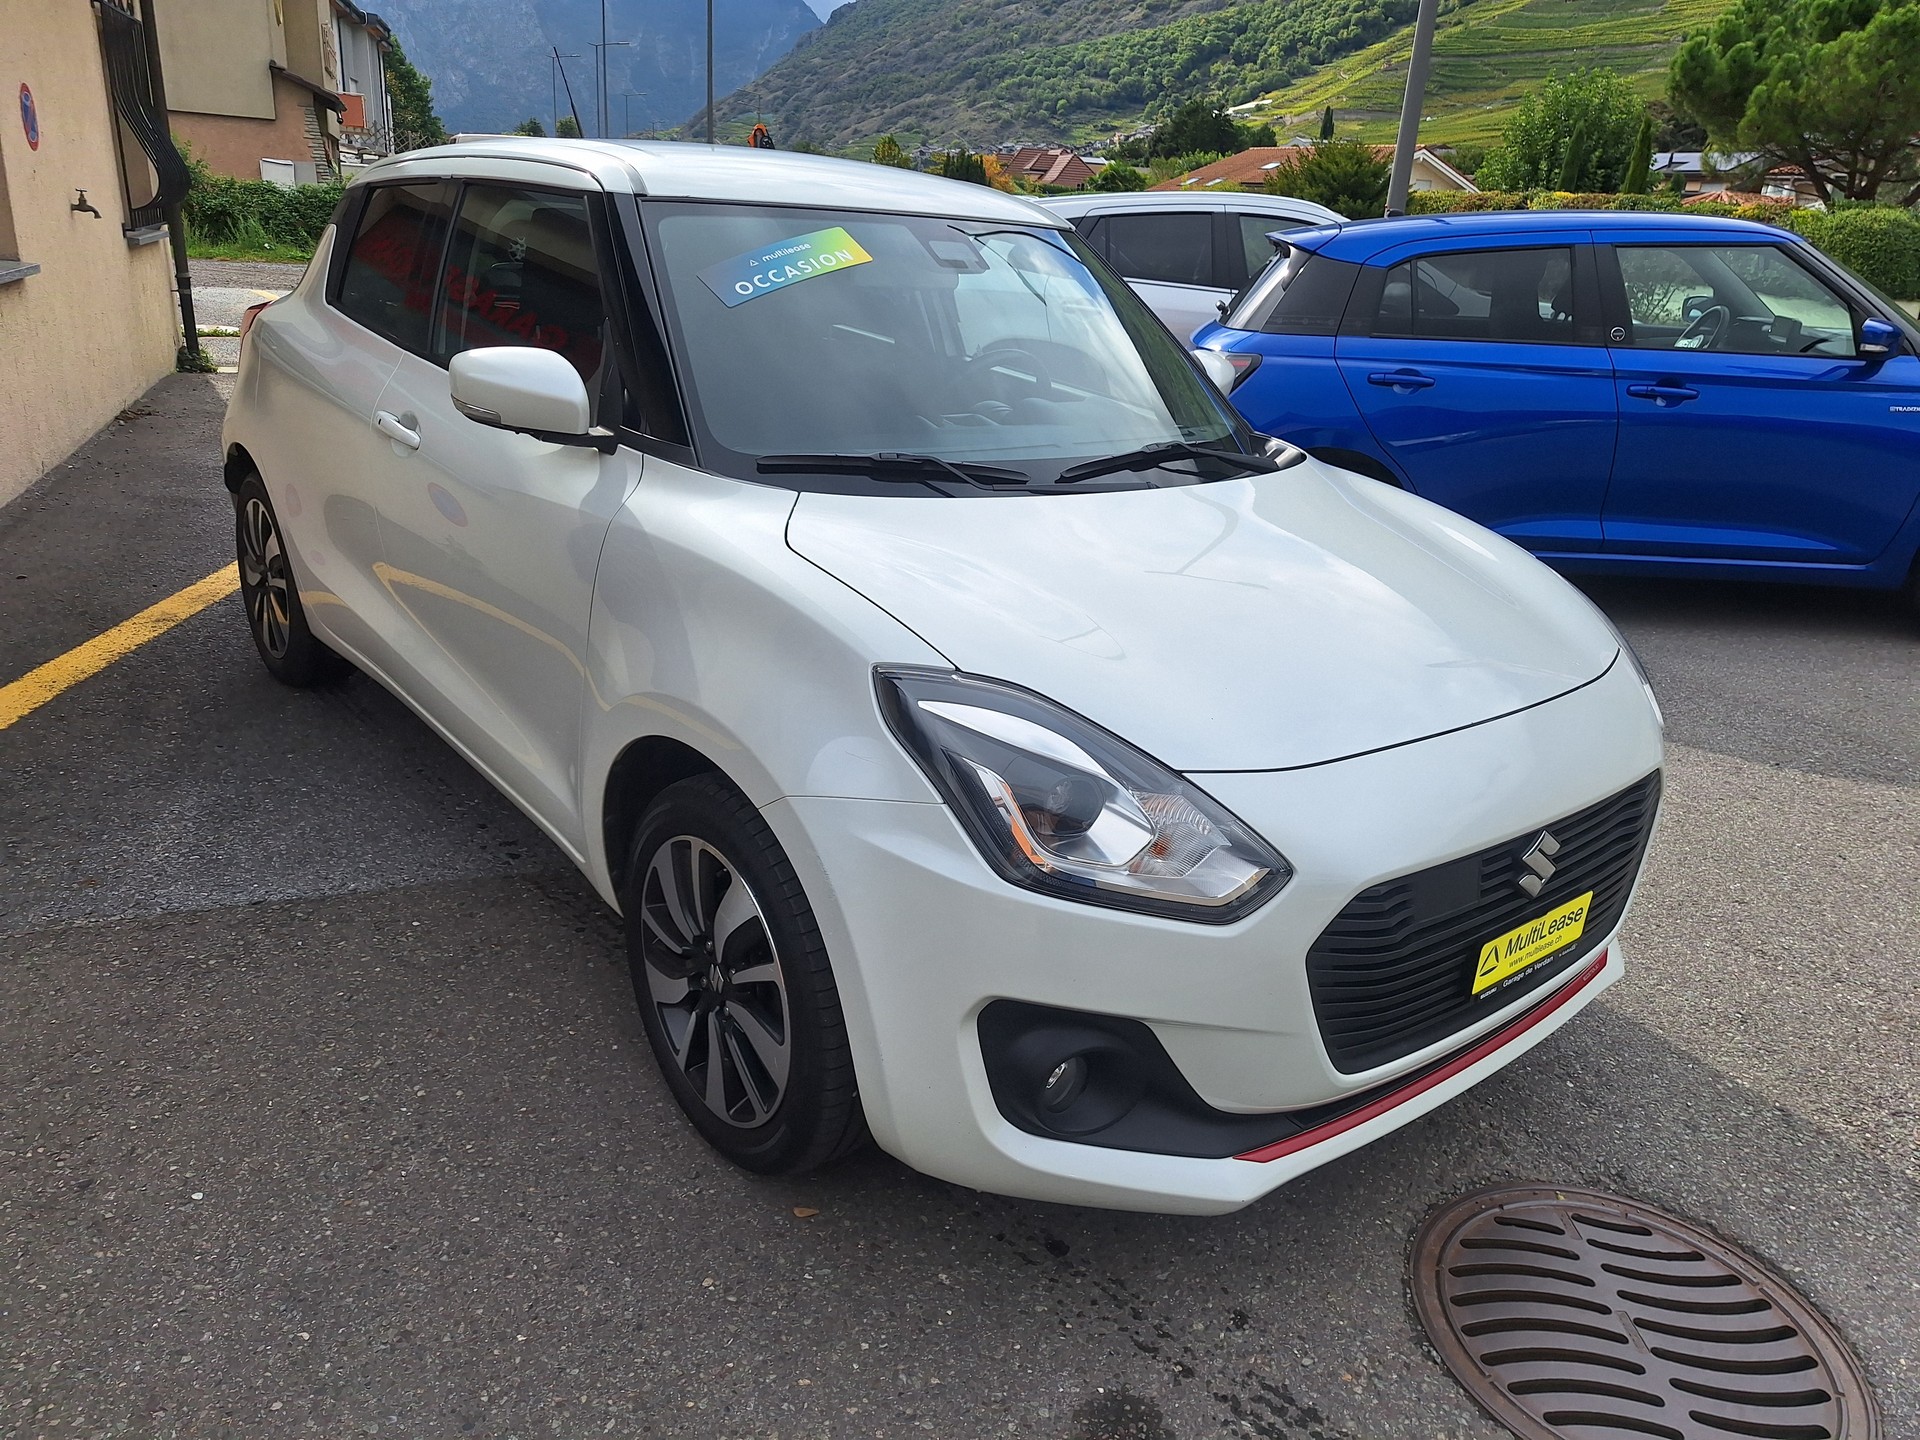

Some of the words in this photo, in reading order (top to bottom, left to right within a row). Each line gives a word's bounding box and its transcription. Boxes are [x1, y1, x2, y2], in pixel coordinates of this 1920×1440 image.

[762, 243, 812, 263] multilease
[734, 249, 855, 295] OCCASION
[1504, 907, 1584, 959] MultiLease
[1508, 934, 1563, 968] www.multilease.ch
[1502, 972, 1525, 988] Garage
[1525, 966, 1534, 976] de
